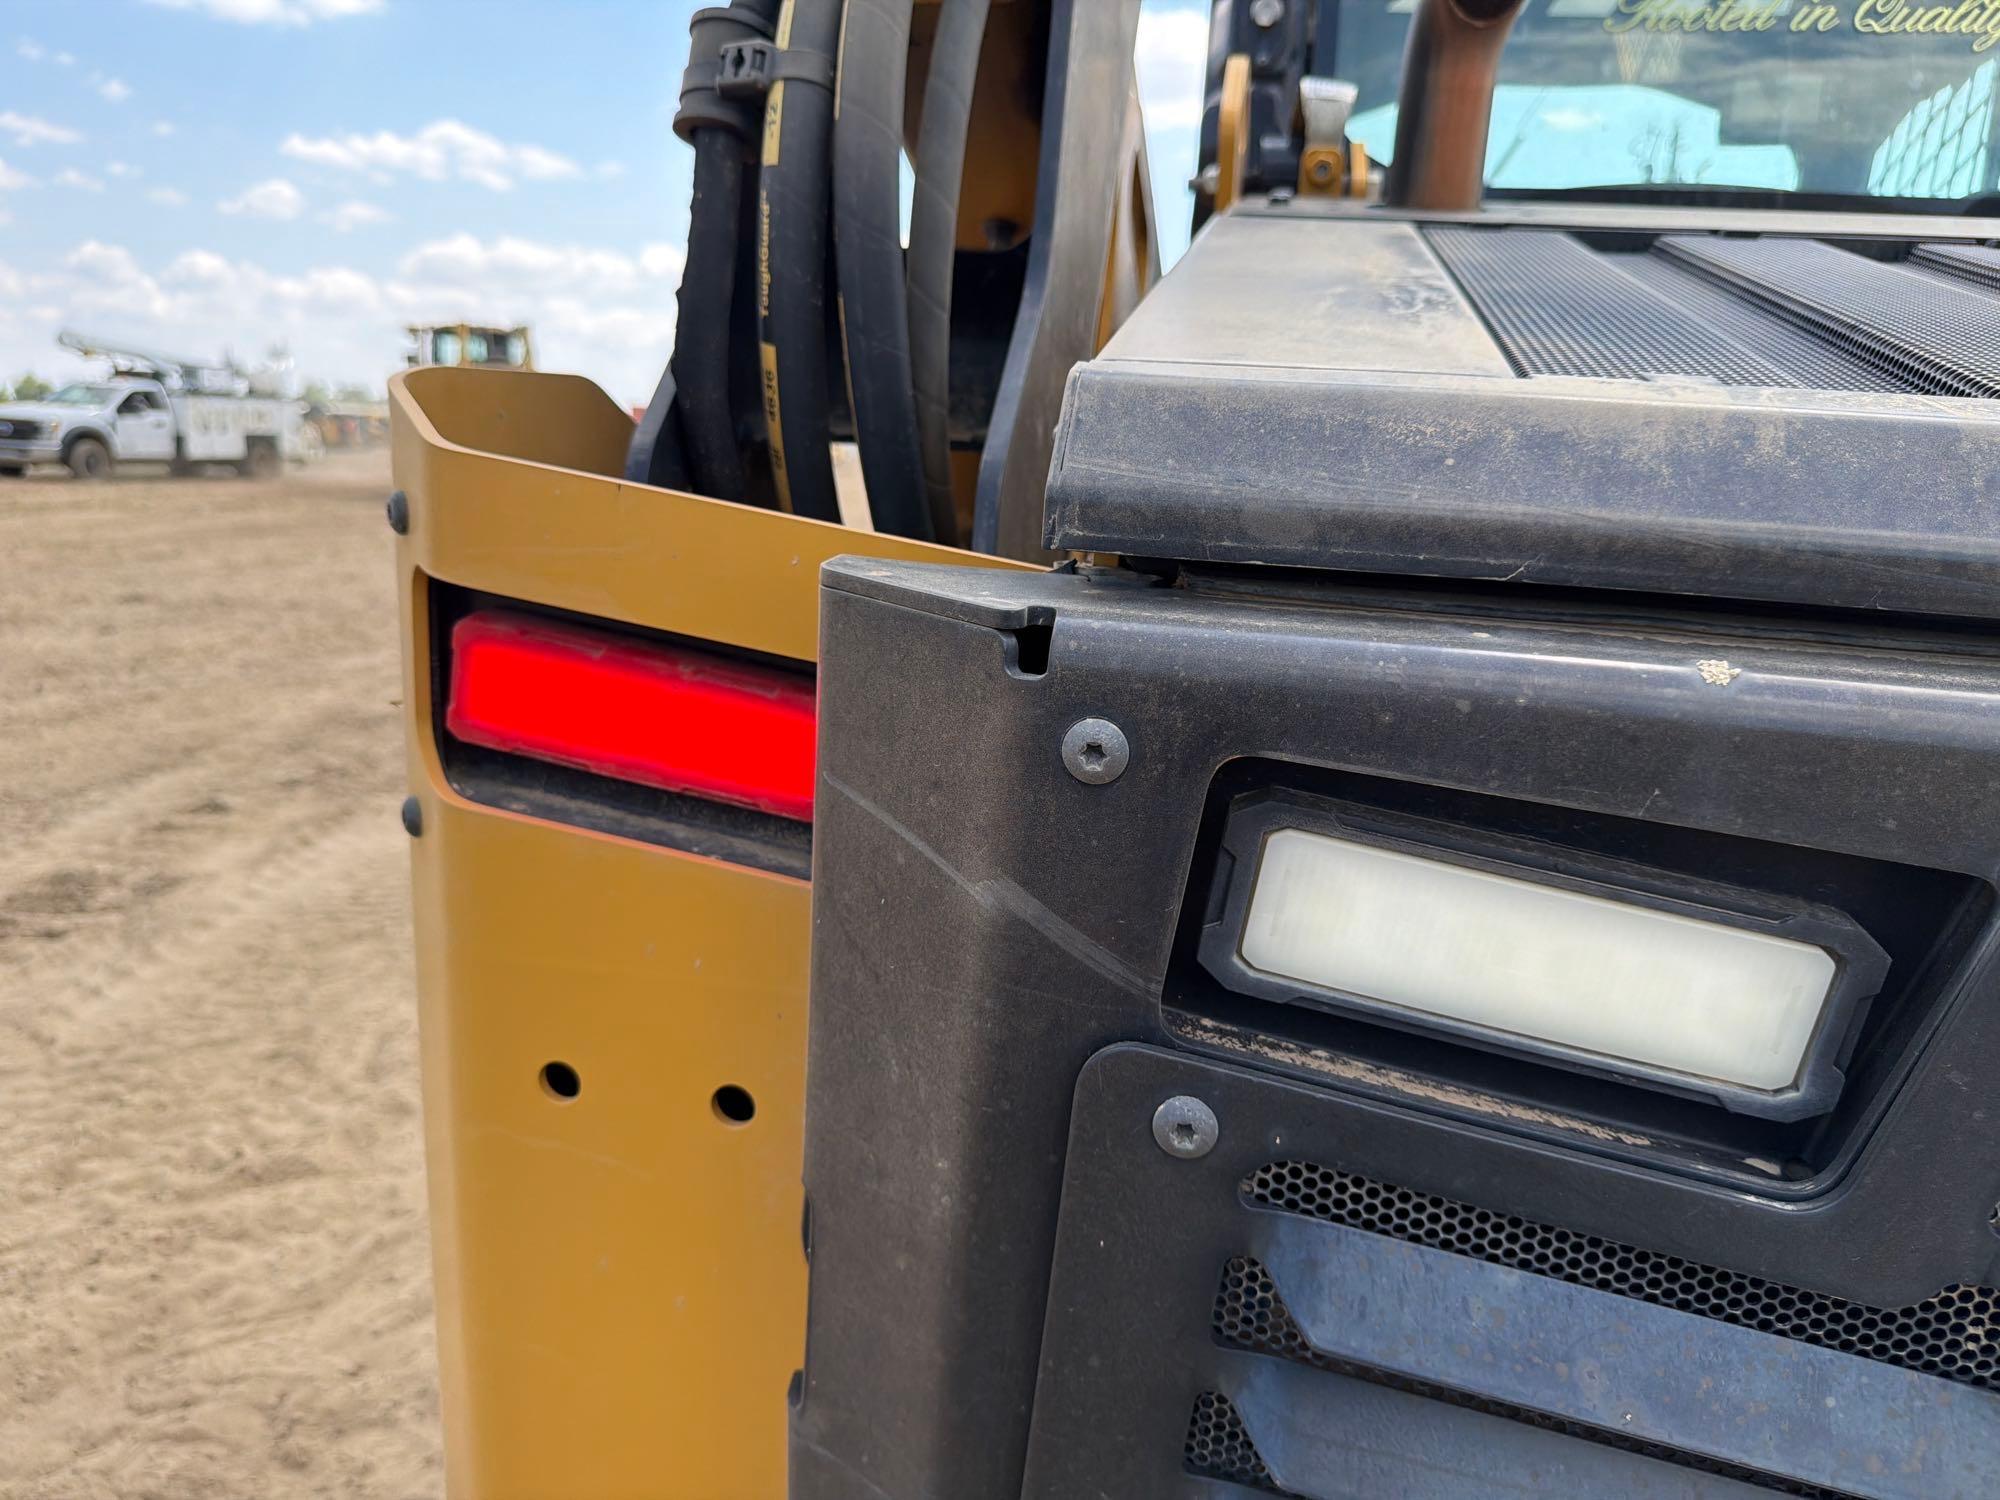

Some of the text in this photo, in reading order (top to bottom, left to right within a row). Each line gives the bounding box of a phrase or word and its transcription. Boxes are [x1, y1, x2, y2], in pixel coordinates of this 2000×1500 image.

[1603, 0, 2000, 52] Rooted in Quality
